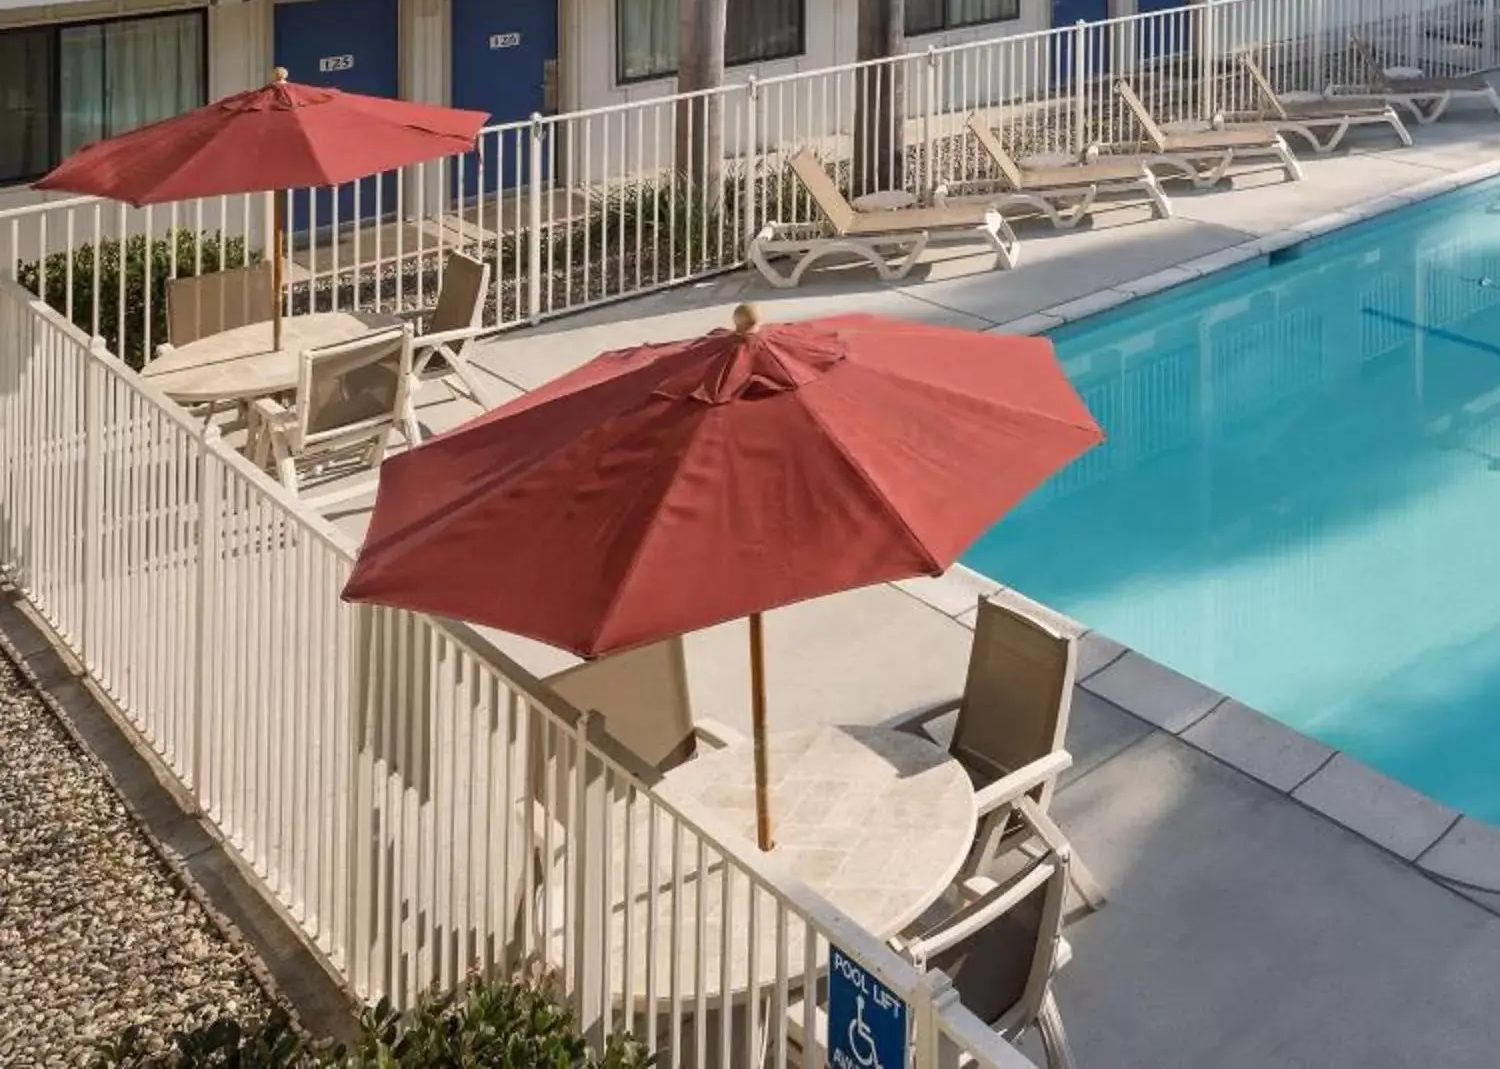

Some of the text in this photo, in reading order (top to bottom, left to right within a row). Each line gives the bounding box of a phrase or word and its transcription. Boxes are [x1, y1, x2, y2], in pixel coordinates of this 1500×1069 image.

[323, 55, 351, 70] 125
[834, 952, 901, 1019] POOL LIFT
